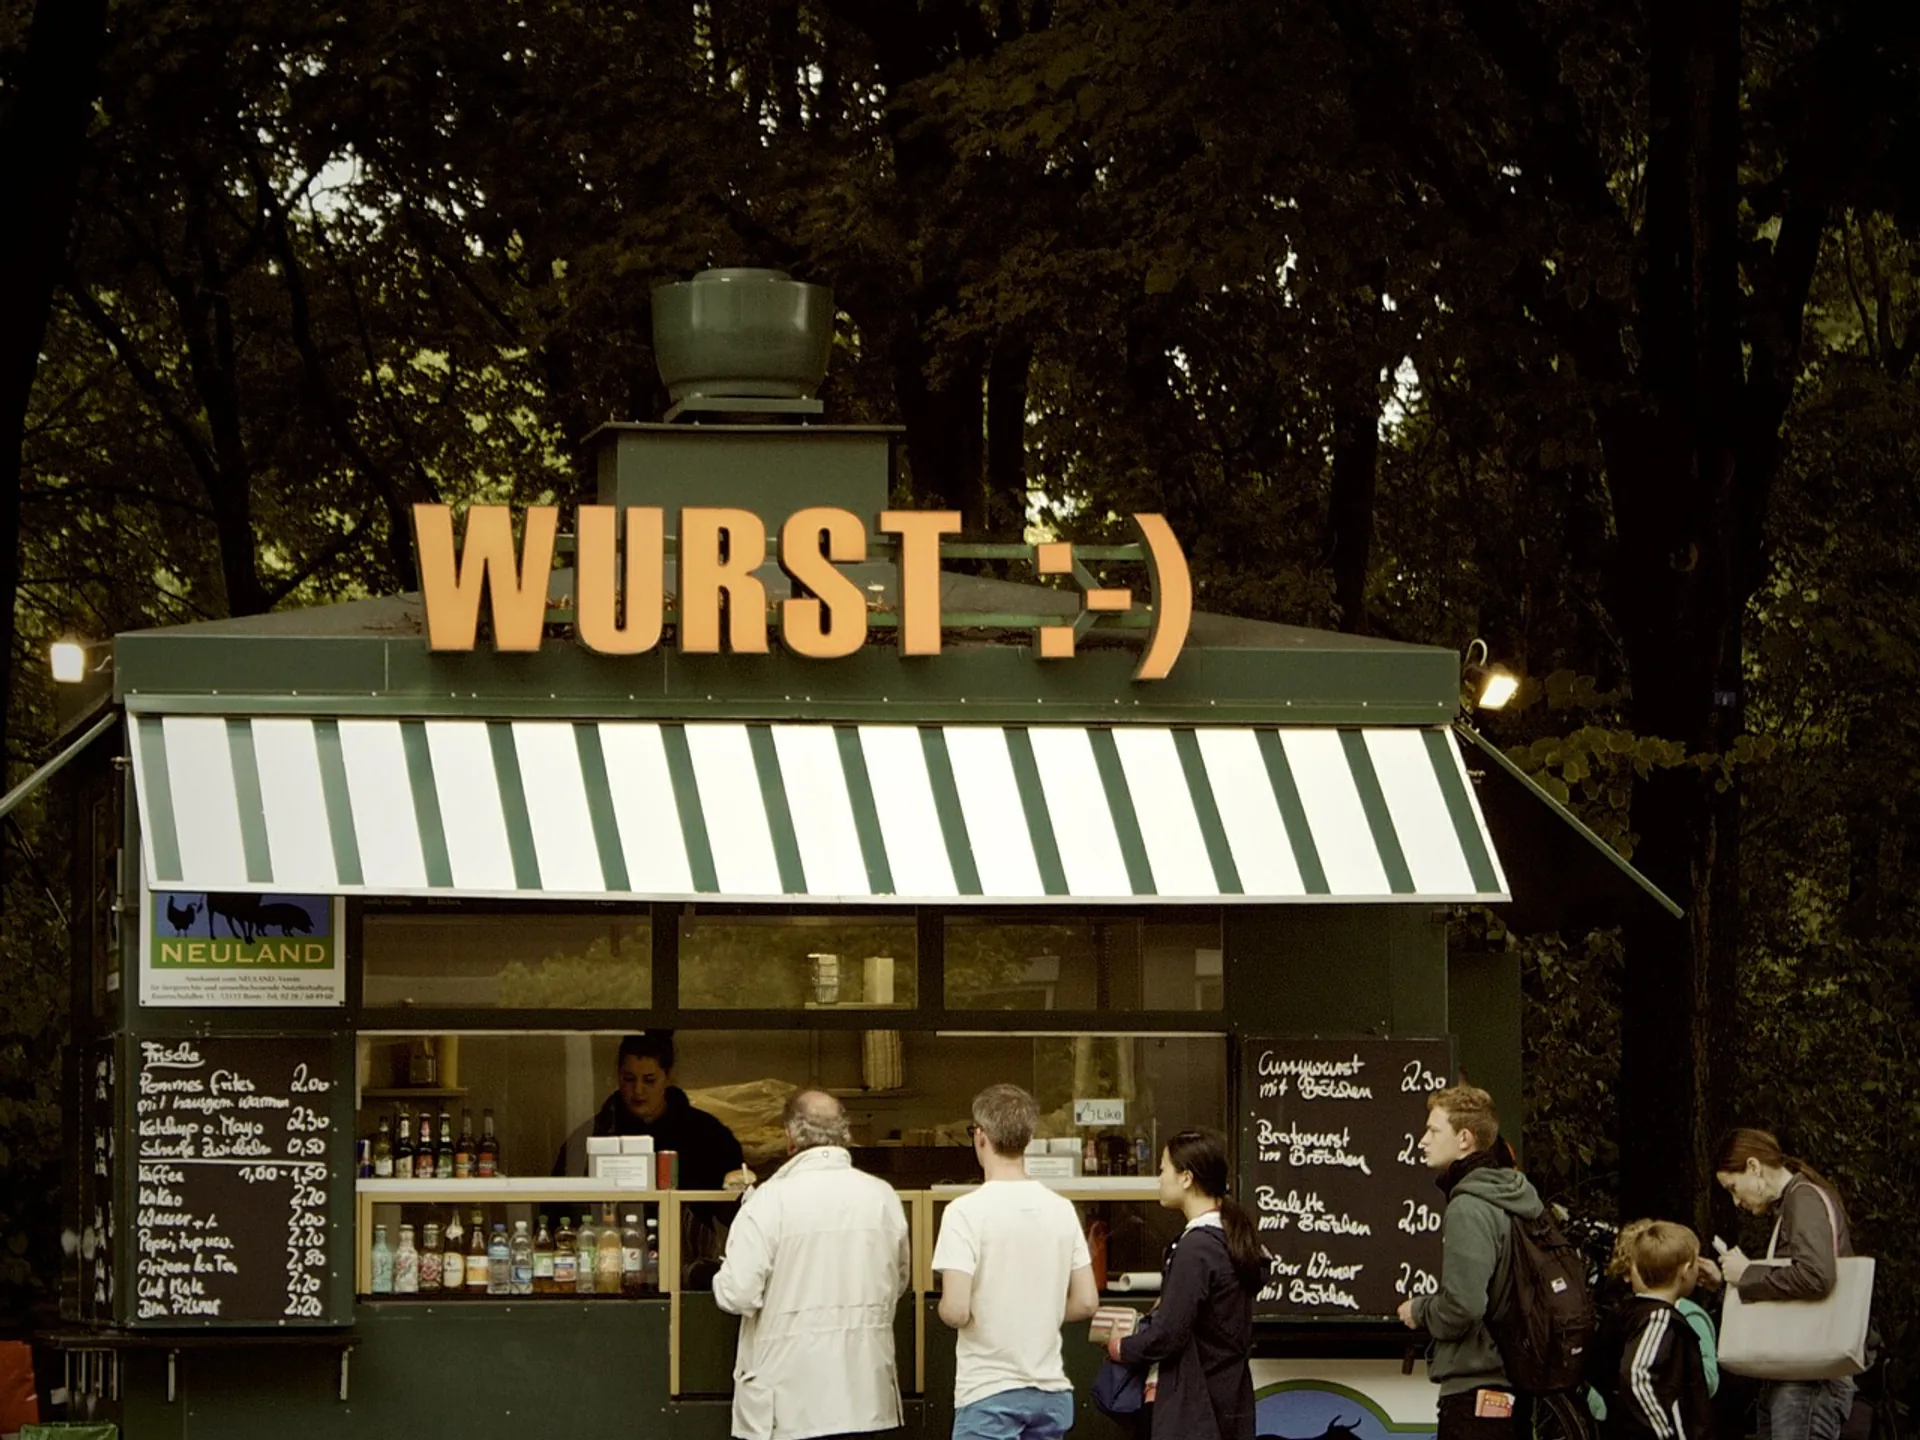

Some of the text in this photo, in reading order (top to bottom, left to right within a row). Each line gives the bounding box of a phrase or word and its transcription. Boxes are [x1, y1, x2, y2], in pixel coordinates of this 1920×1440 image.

[412, 503, 962, 660] WURST
[160, 943, 326, 963] NEULAND
[1258, 1050, 1366, 1090] Currywurst
[140, 1072, 204, 1094] Pommes
[1259, 1077, 1289, 1099] mit
[1096, 1108, 1122, 1121] Like
[220, 1115, 263, 1140] Mayo
[1256, 1118, 1351, 1149] Bratwurst
[286, 1137, 326, 1157] 0,50
[1258, 1145, 1282, 1162] im
[138, 1164, 185, 1185] Kaffee
[1255, 1185, 1326, 1214] Boulette
[1257, 1213, 1290, 1232] mit
